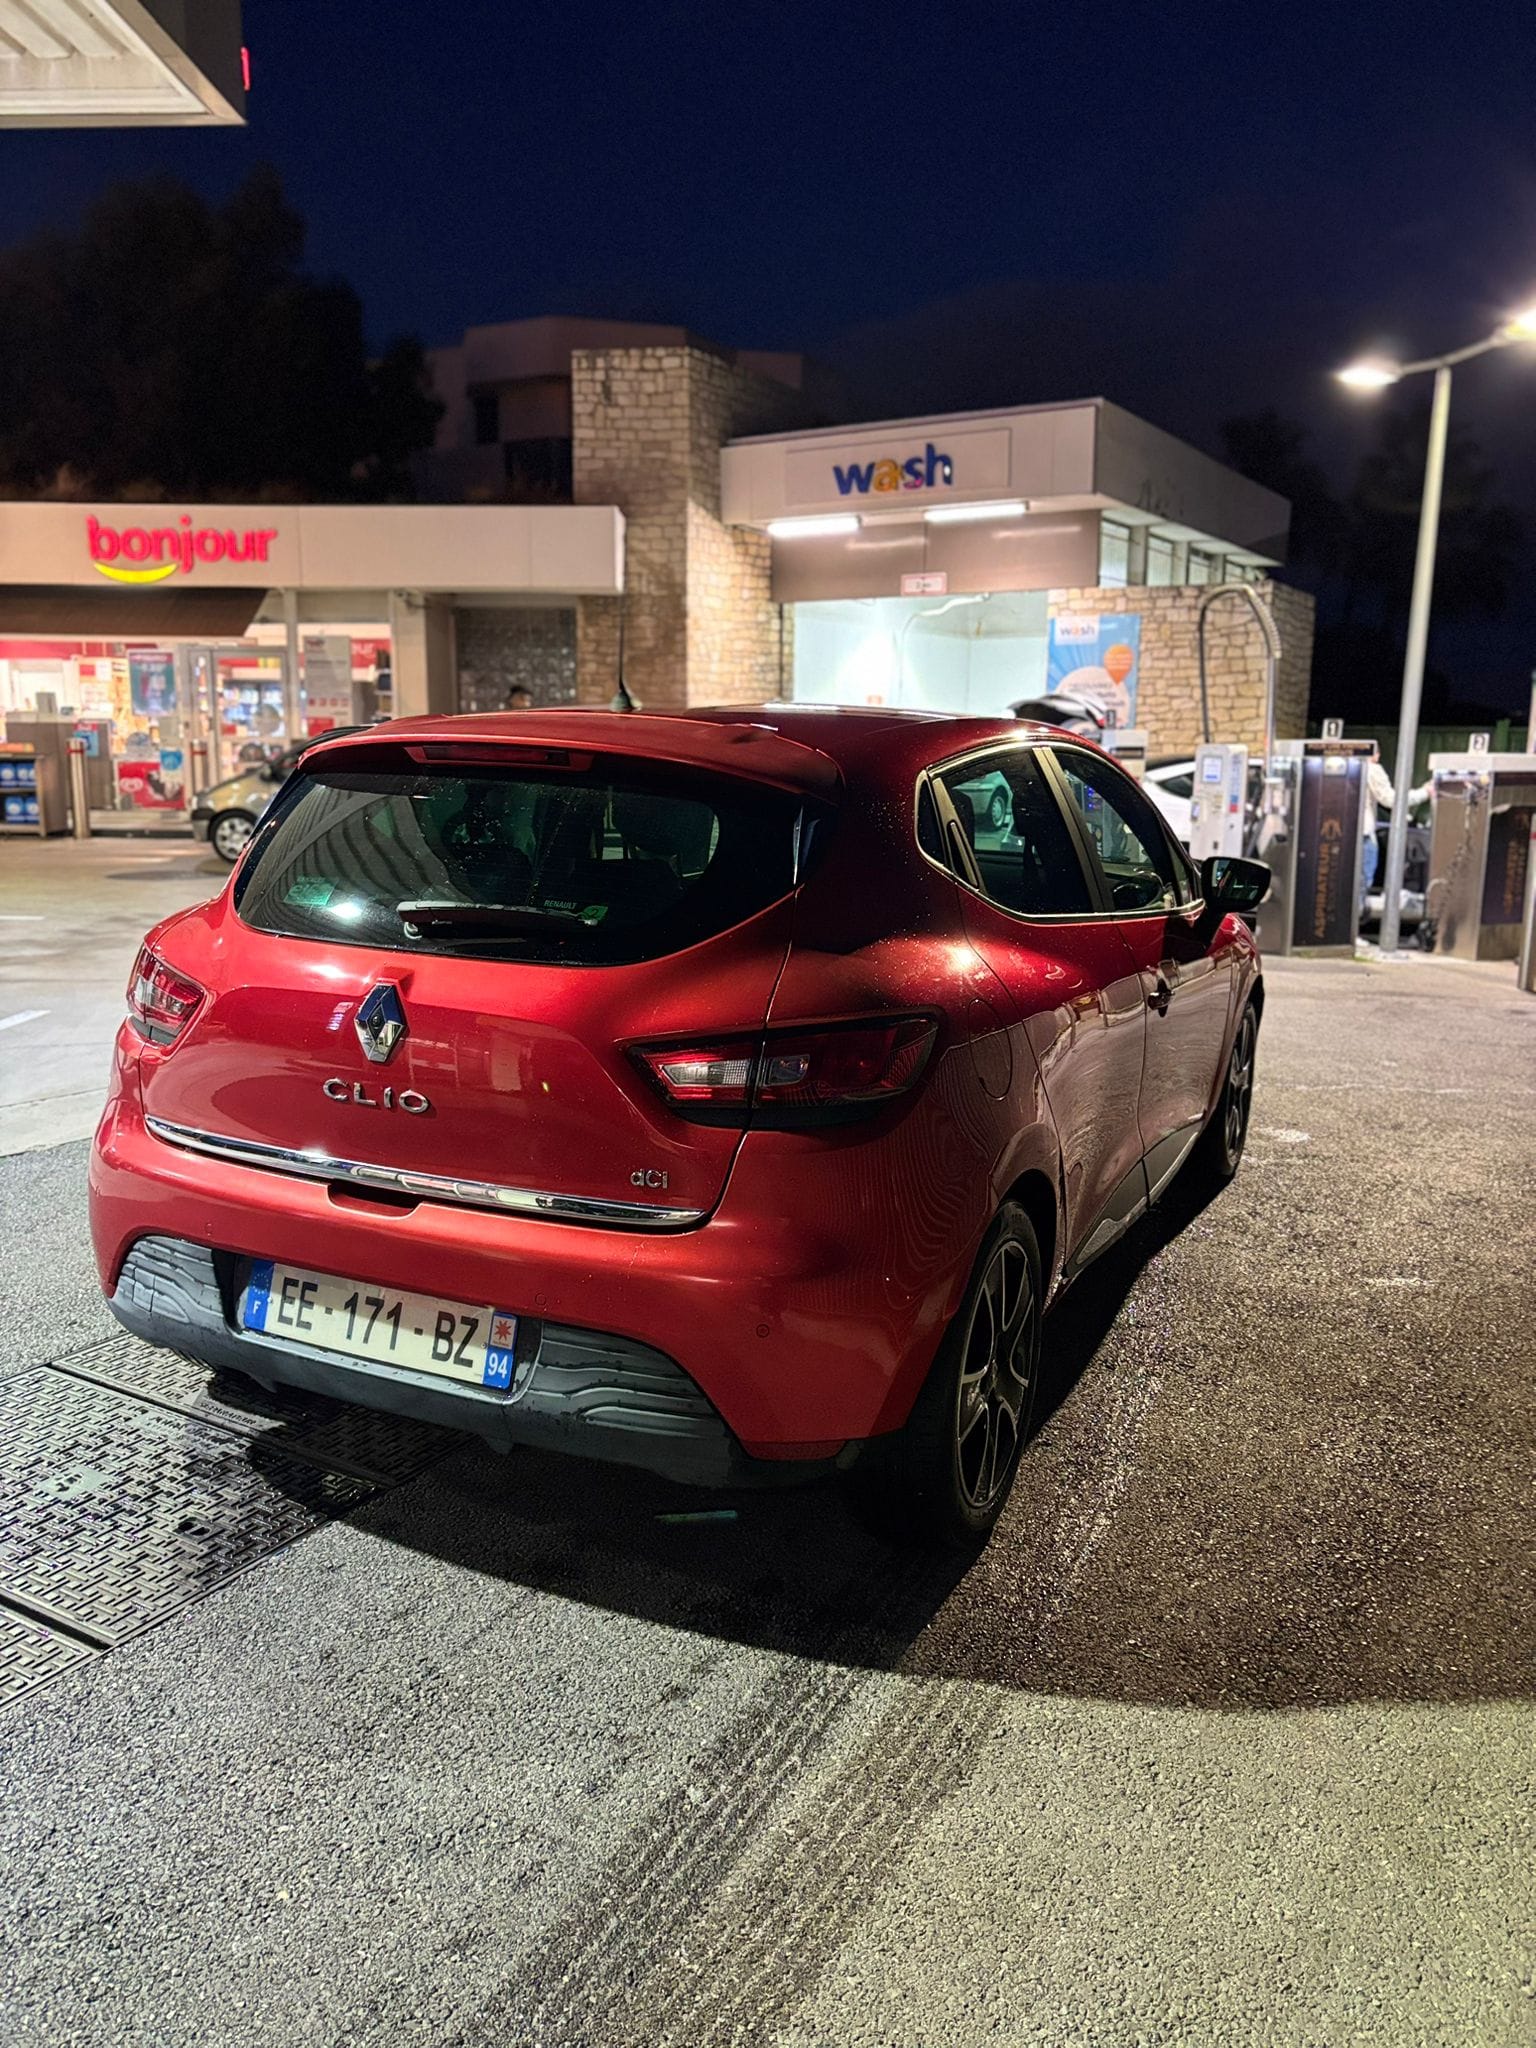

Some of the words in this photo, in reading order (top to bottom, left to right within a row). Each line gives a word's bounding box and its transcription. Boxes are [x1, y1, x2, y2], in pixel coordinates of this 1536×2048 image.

[833, 442, 954, 496] wash
[85, 513, 279, 575] bonjour
[1059, 622, 1096, 637] wash
[544, 899, 578, 910] RENAULT
[1314, 842, 1330, 939] ASPIRATEUR
[322, 1077, 430, 1114] CLIO
[252, 1300, 262, 1315] F
[277, 1276, 480, 1368] EE-171-BZ
[487, 1352, 509, 1379] 94
